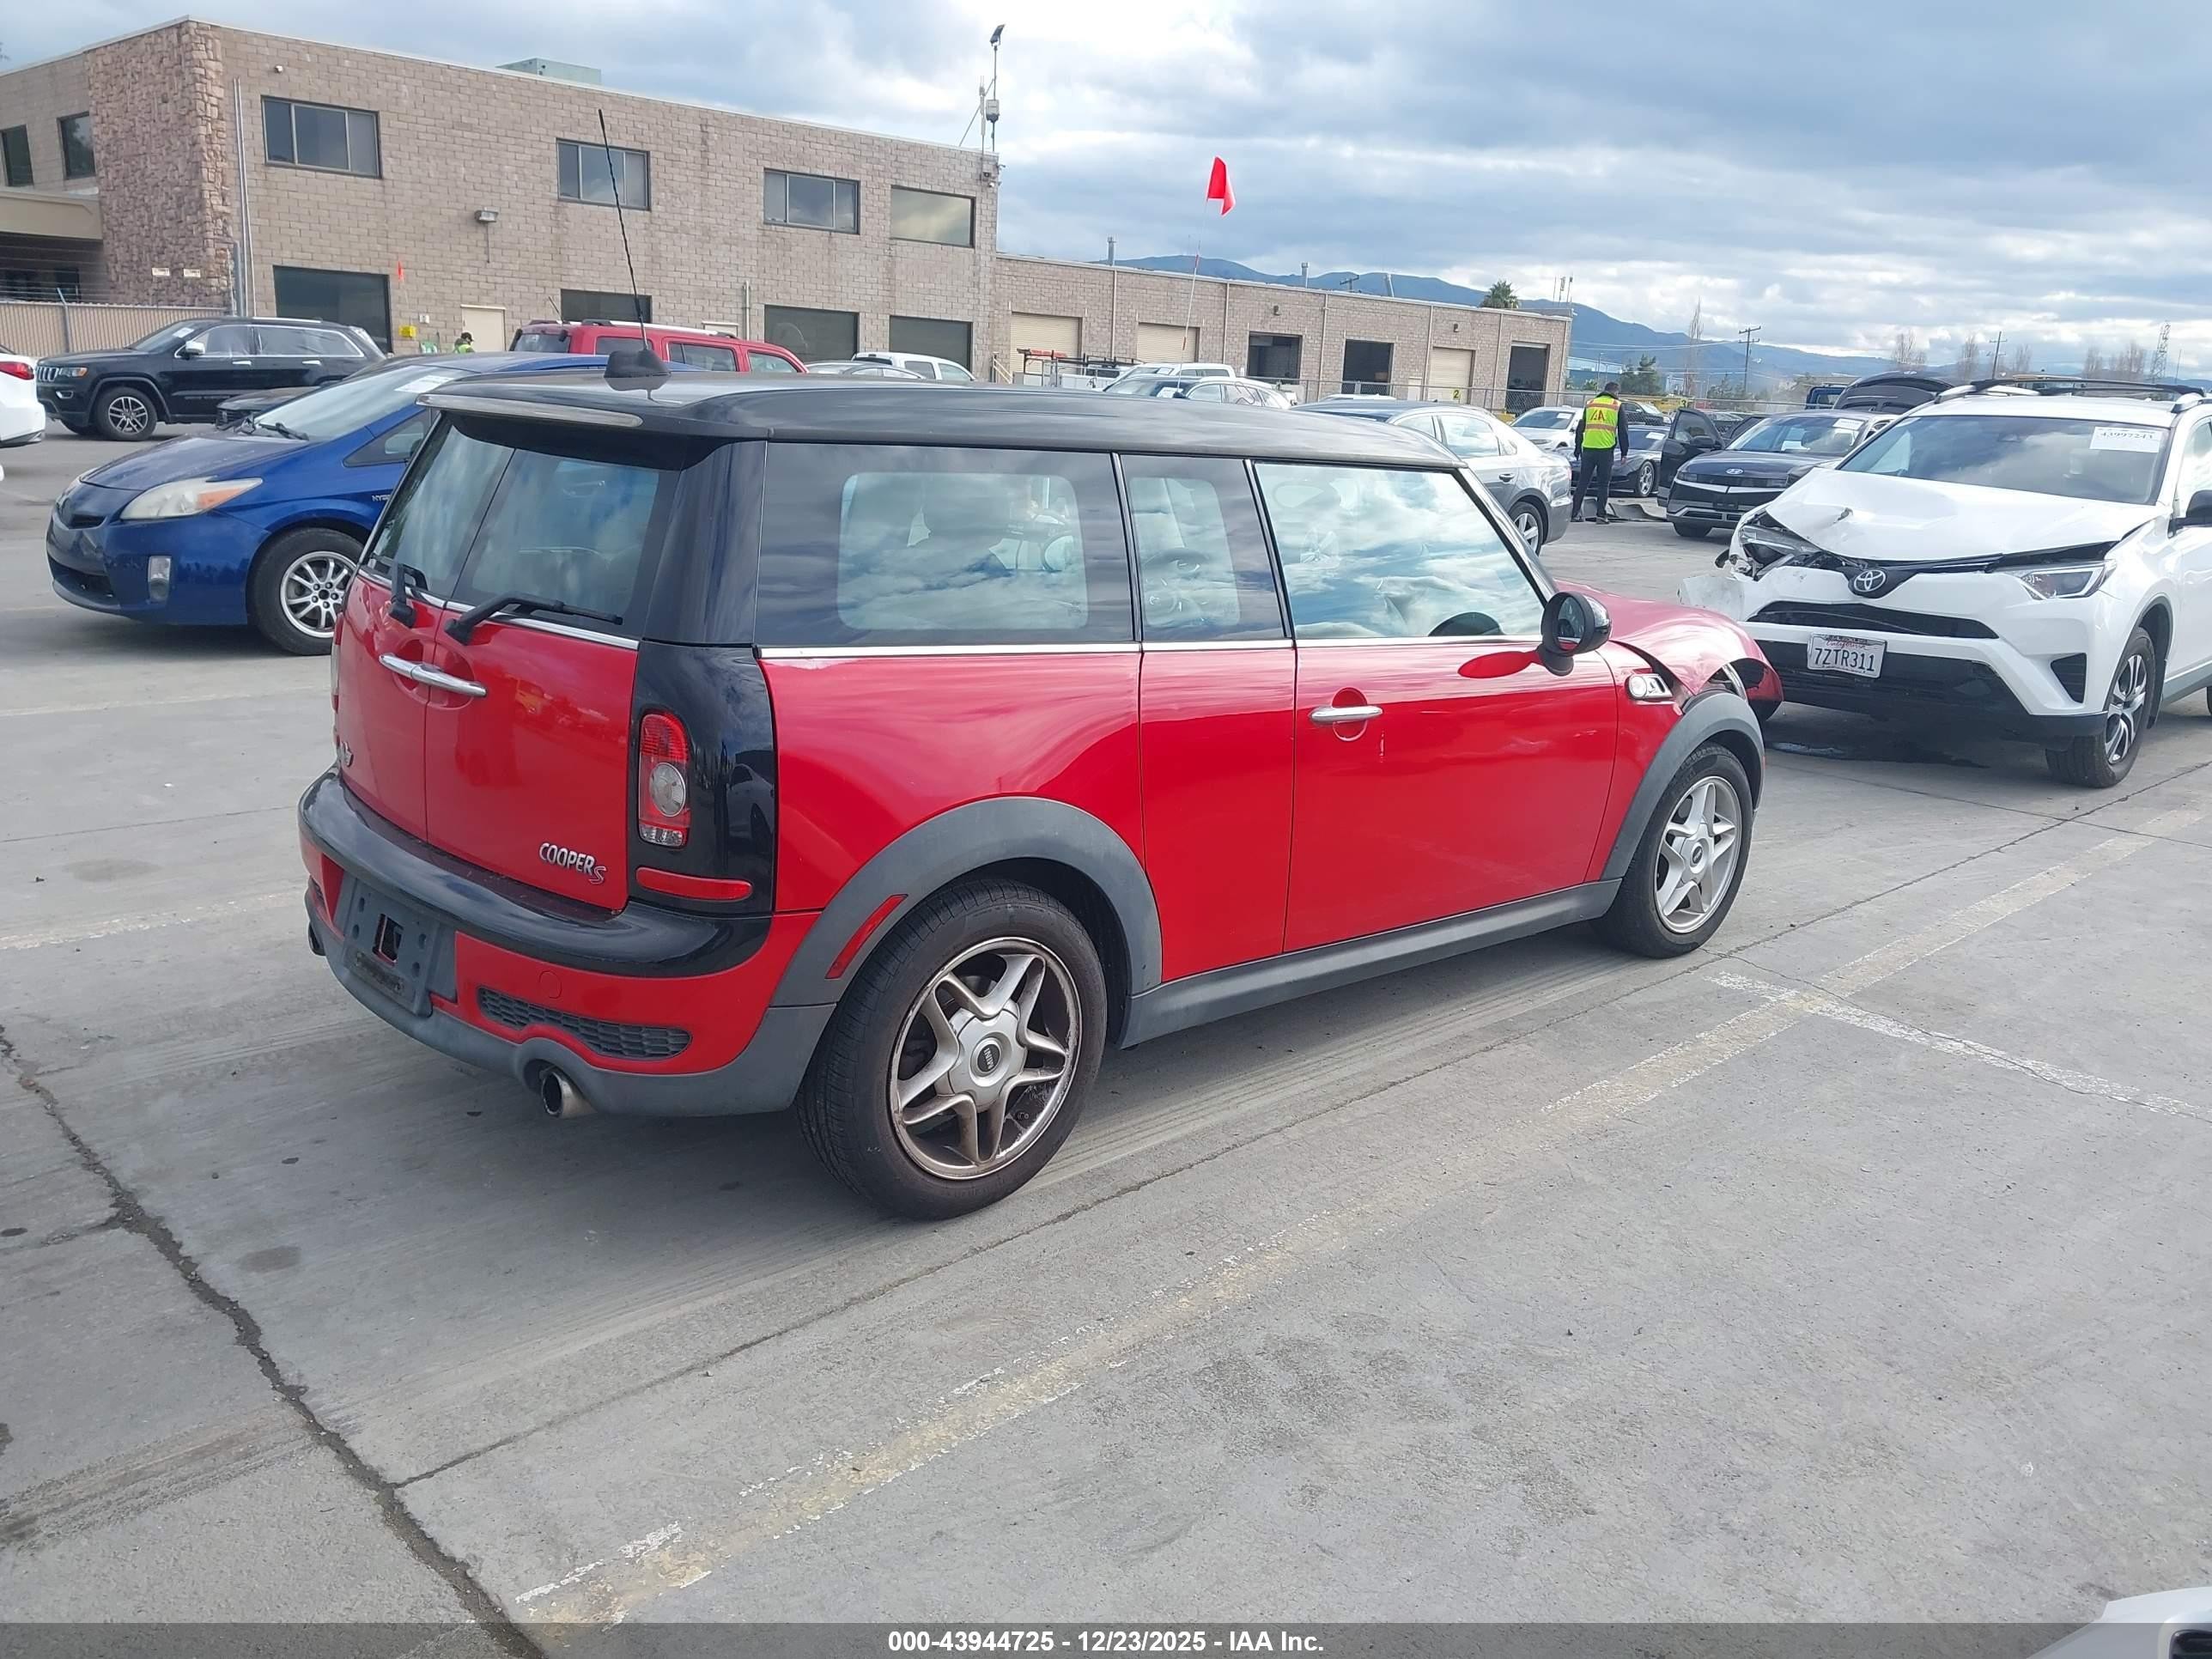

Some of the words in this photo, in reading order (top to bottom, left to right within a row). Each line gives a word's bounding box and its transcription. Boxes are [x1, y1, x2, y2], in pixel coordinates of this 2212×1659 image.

[1453, 389, 1460, 399] 2
[1814, 647, 1875, 672] 7ZTR311
[539, 842, 595, 876] COOPER
